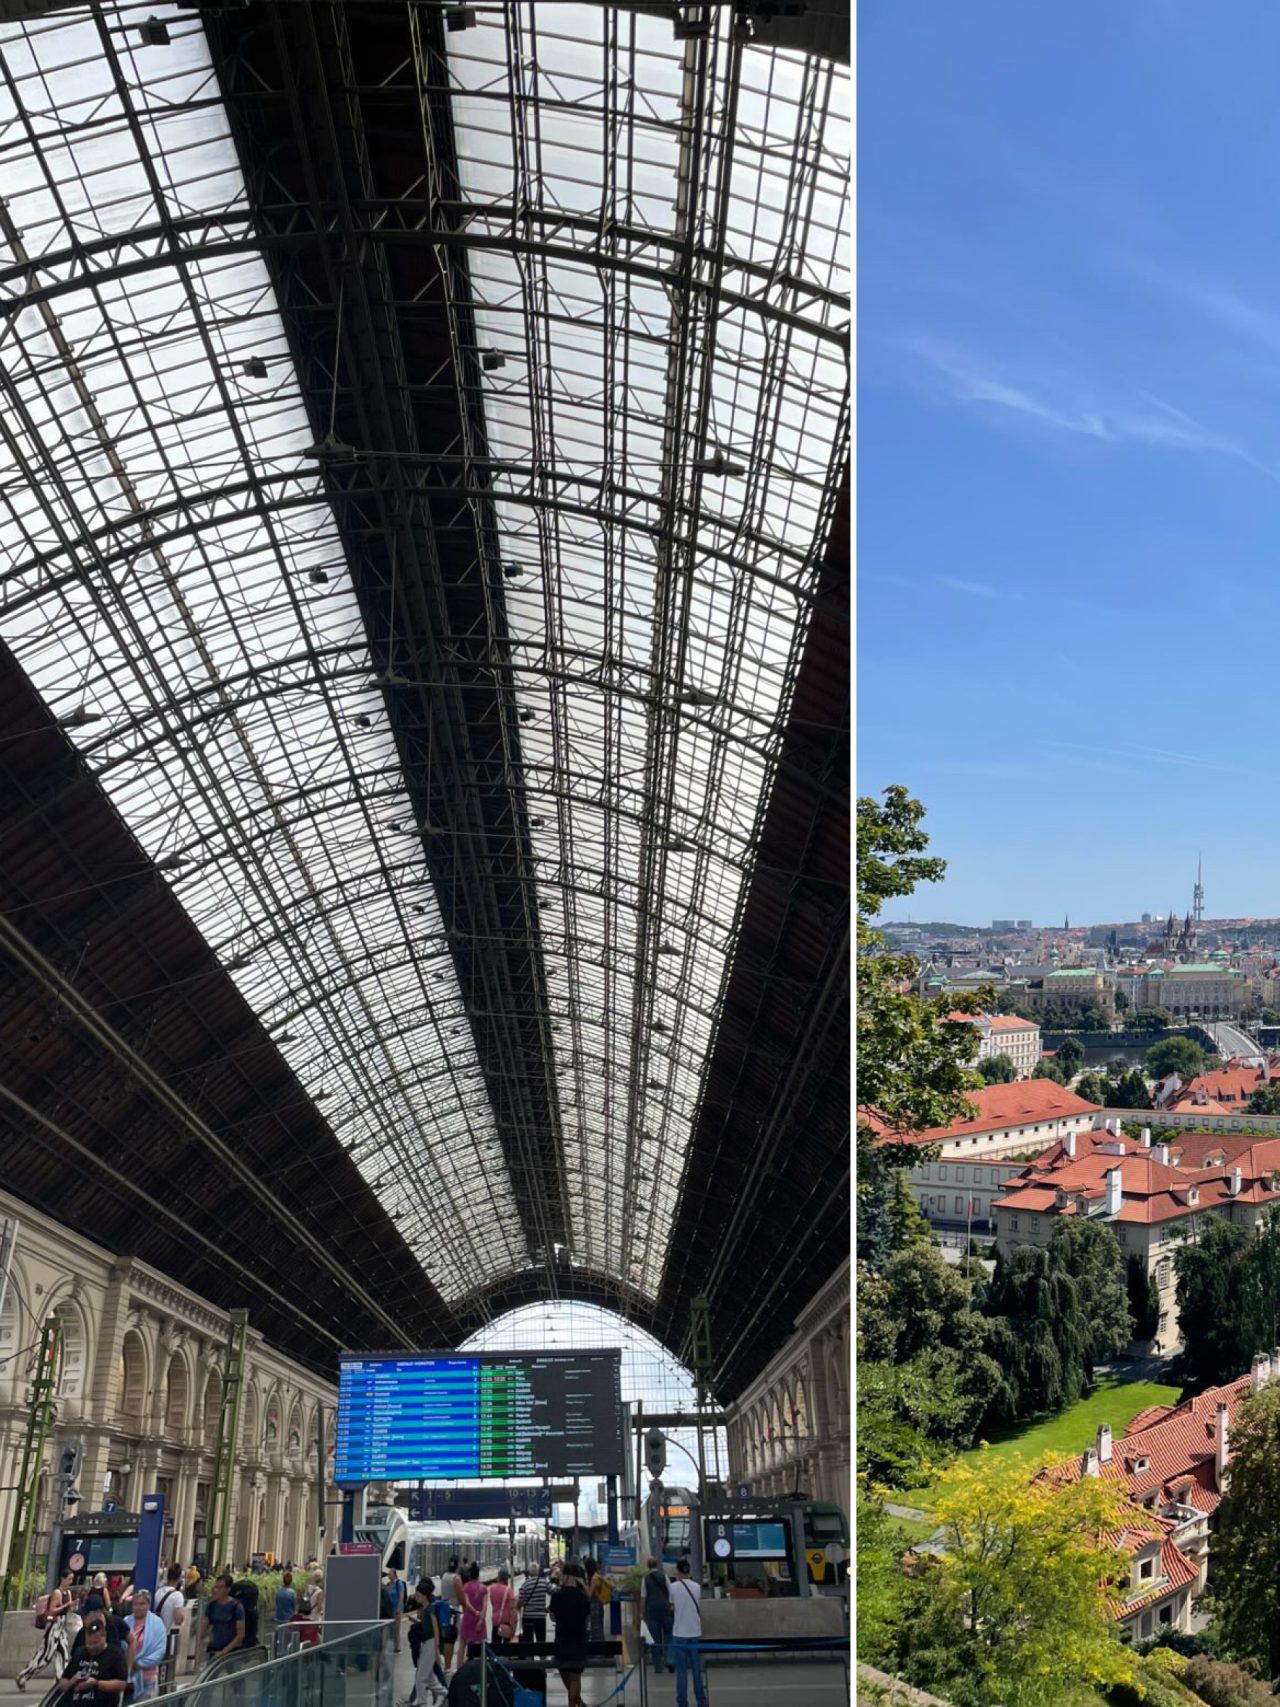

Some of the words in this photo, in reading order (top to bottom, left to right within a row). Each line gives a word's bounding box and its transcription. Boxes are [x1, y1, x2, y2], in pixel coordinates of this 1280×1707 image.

[108, 1503, 114, 1513] 7
[717, 1524, 726, 1537] 8
[75, 1539, 84, 1551] 7
